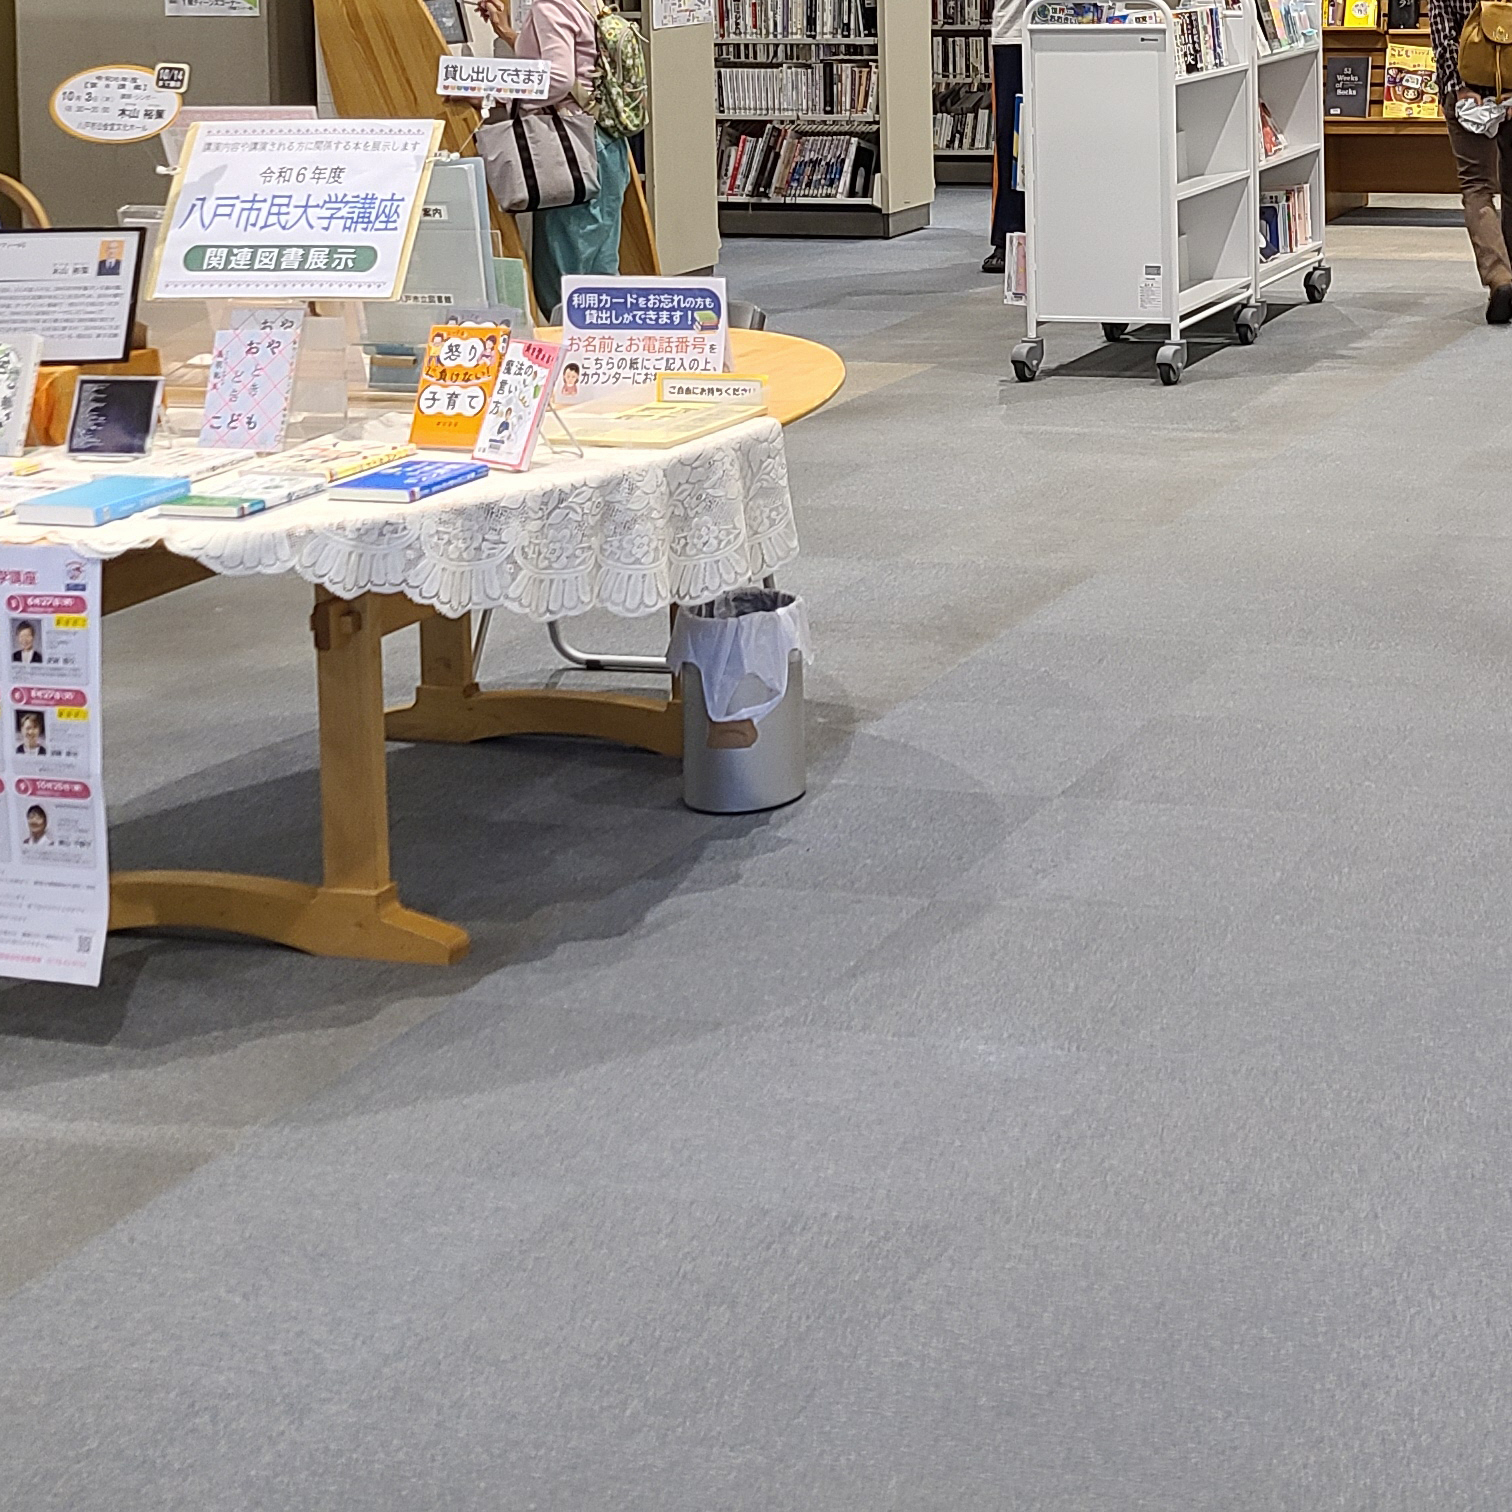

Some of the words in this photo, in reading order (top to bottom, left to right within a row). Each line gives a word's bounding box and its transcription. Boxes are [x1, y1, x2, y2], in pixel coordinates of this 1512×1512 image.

[442, 64, 548, 86] 貸し出しできます
[1336, 74, 1359, 82] Weeks
[178, 192, 406, 233] 八戸市民大学講座
[202, 246, 356, 271] 関連図書展示
[571, 293, 715, 310] 利用カードをお忘れの方も
[584, 310, 693, 326] 貸出しができます！
[245, 339, 282, 356] おや
[443, 343, 478, 363] 怒り
[567, 335, 718, 355] お名前とお電話番号を
[502, 359, 534, 377] 魔法の
[581, 356, 718, 372] こちらの紙にご記入の上、
[496, 379, 518, 395] 言い
[424, 391, 480, 411] 子育て
[489, 399, 504, 416] 方
[209, 412, 258, 431] こども
